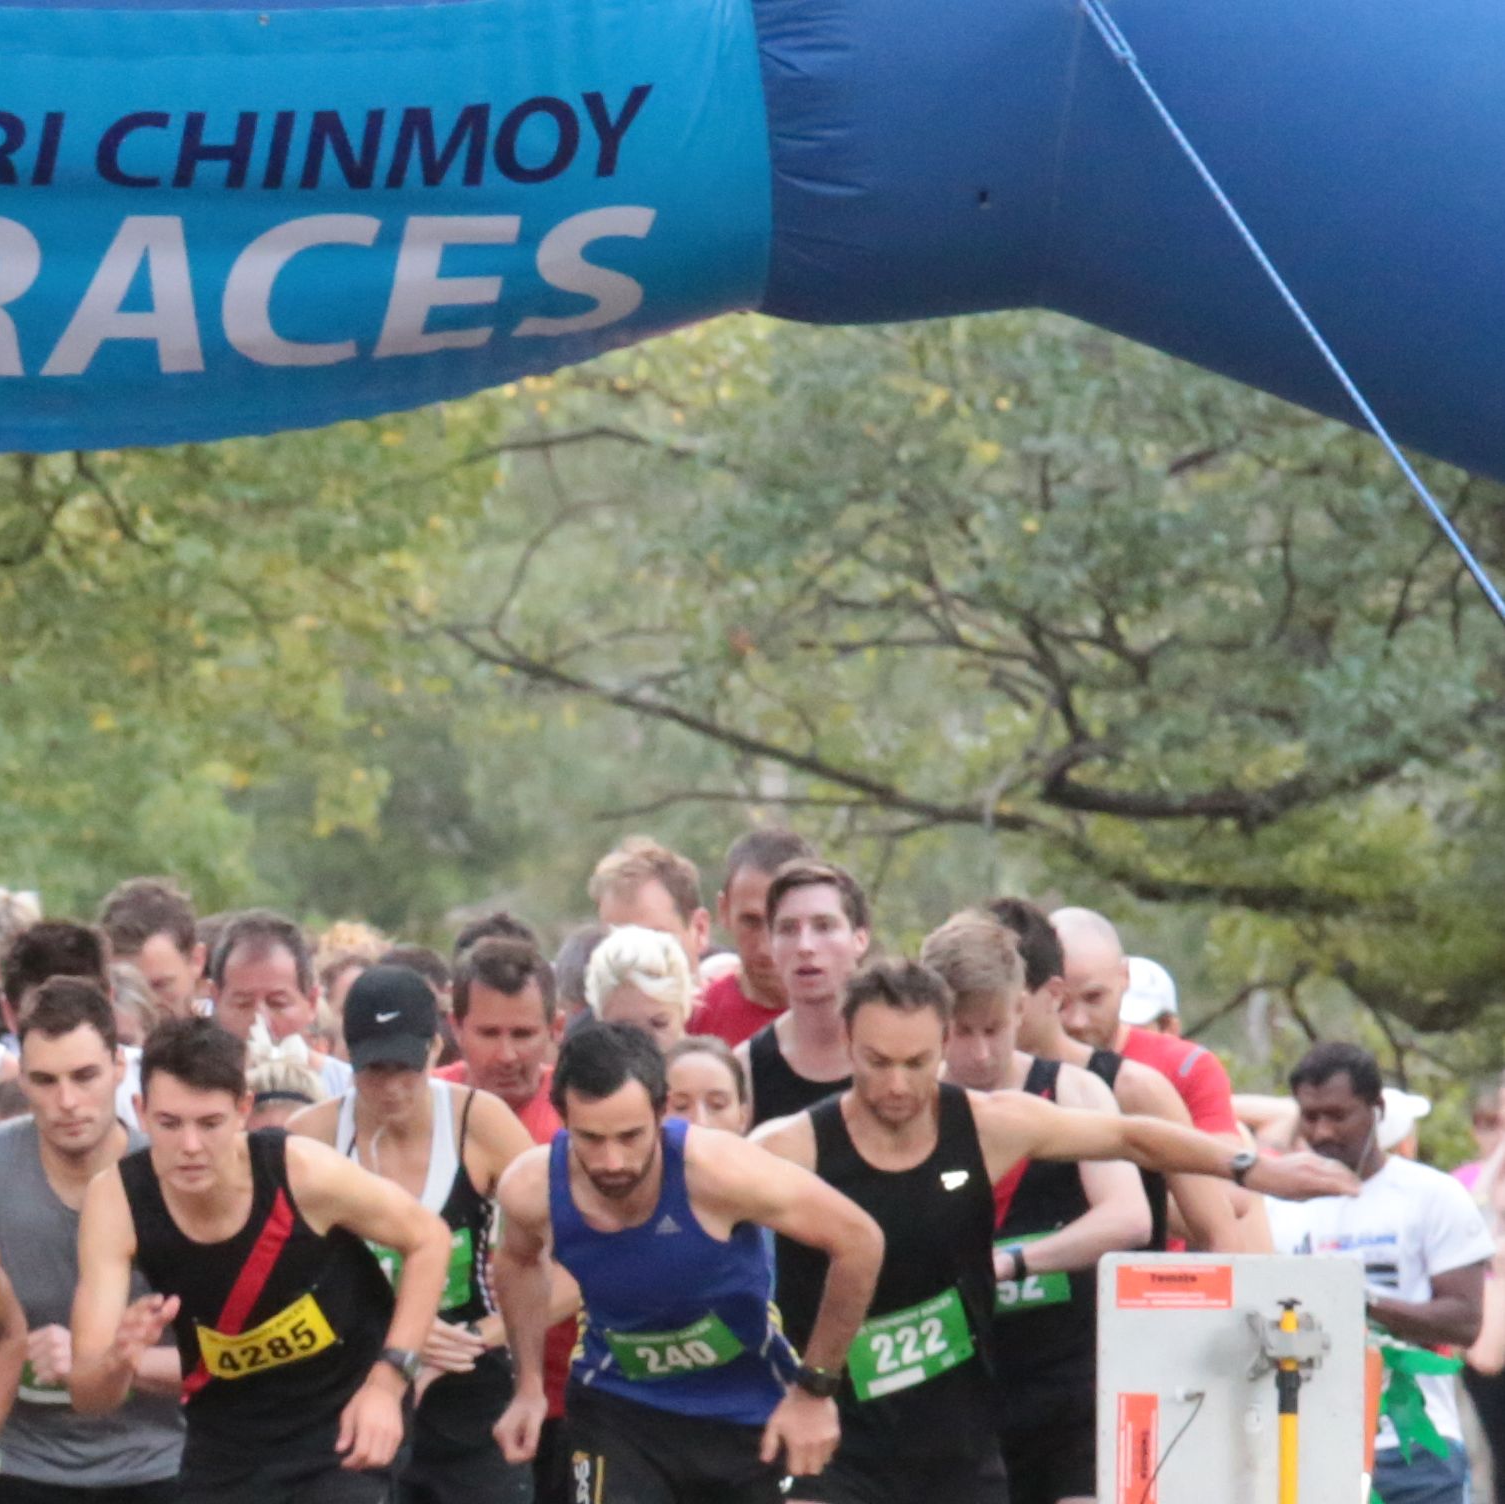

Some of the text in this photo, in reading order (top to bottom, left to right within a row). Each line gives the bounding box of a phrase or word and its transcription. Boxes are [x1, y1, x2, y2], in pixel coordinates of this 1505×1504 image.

[95, 83, 654, 190] CHINMOY
[217, 1317, 318, 1372] 4285
[635, 1339, 718, 1374] 240
[869, 1316, 949, 1375] 222
